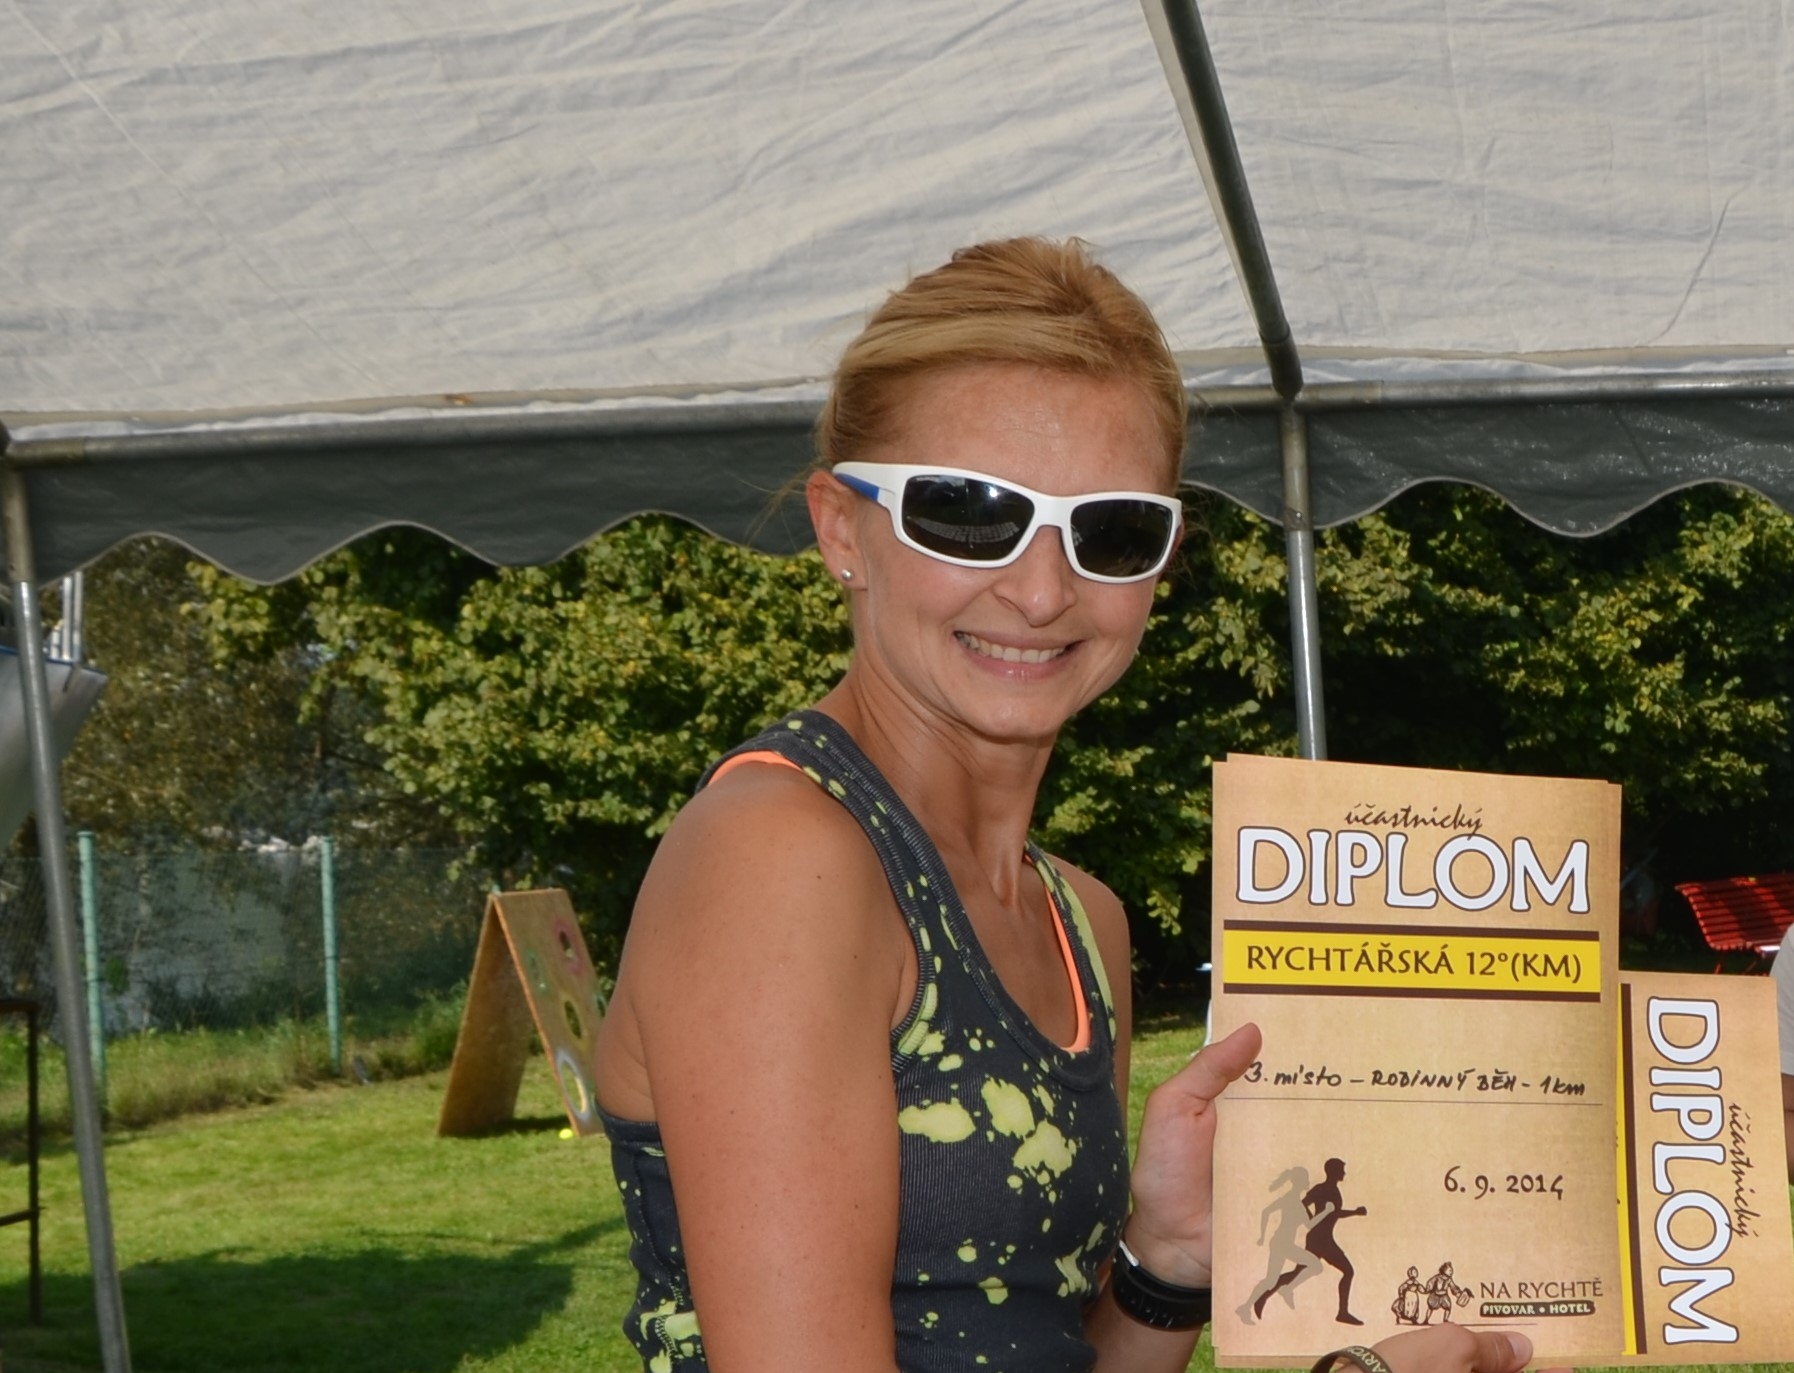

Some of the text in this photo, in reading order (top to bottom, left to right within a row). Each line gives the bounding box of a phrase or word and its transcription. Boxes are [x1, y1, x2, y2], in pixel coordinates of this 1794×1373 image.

[1345, 803, 1483, 841] účastnický
[1236, 825, 1591, 914] DIPLOM
[1246, 942, 1455, 975] RYCHTÁŘSKÁ
[1646, 996, 1740, 1345] DIPLOM
[1506, 1174, 1564, 1201] 2014
[1479, 1276, 1604, 1300] NA RYCHTĚ
[1482, 1302, 1591, 1316] PIVOVAR HOTEL
